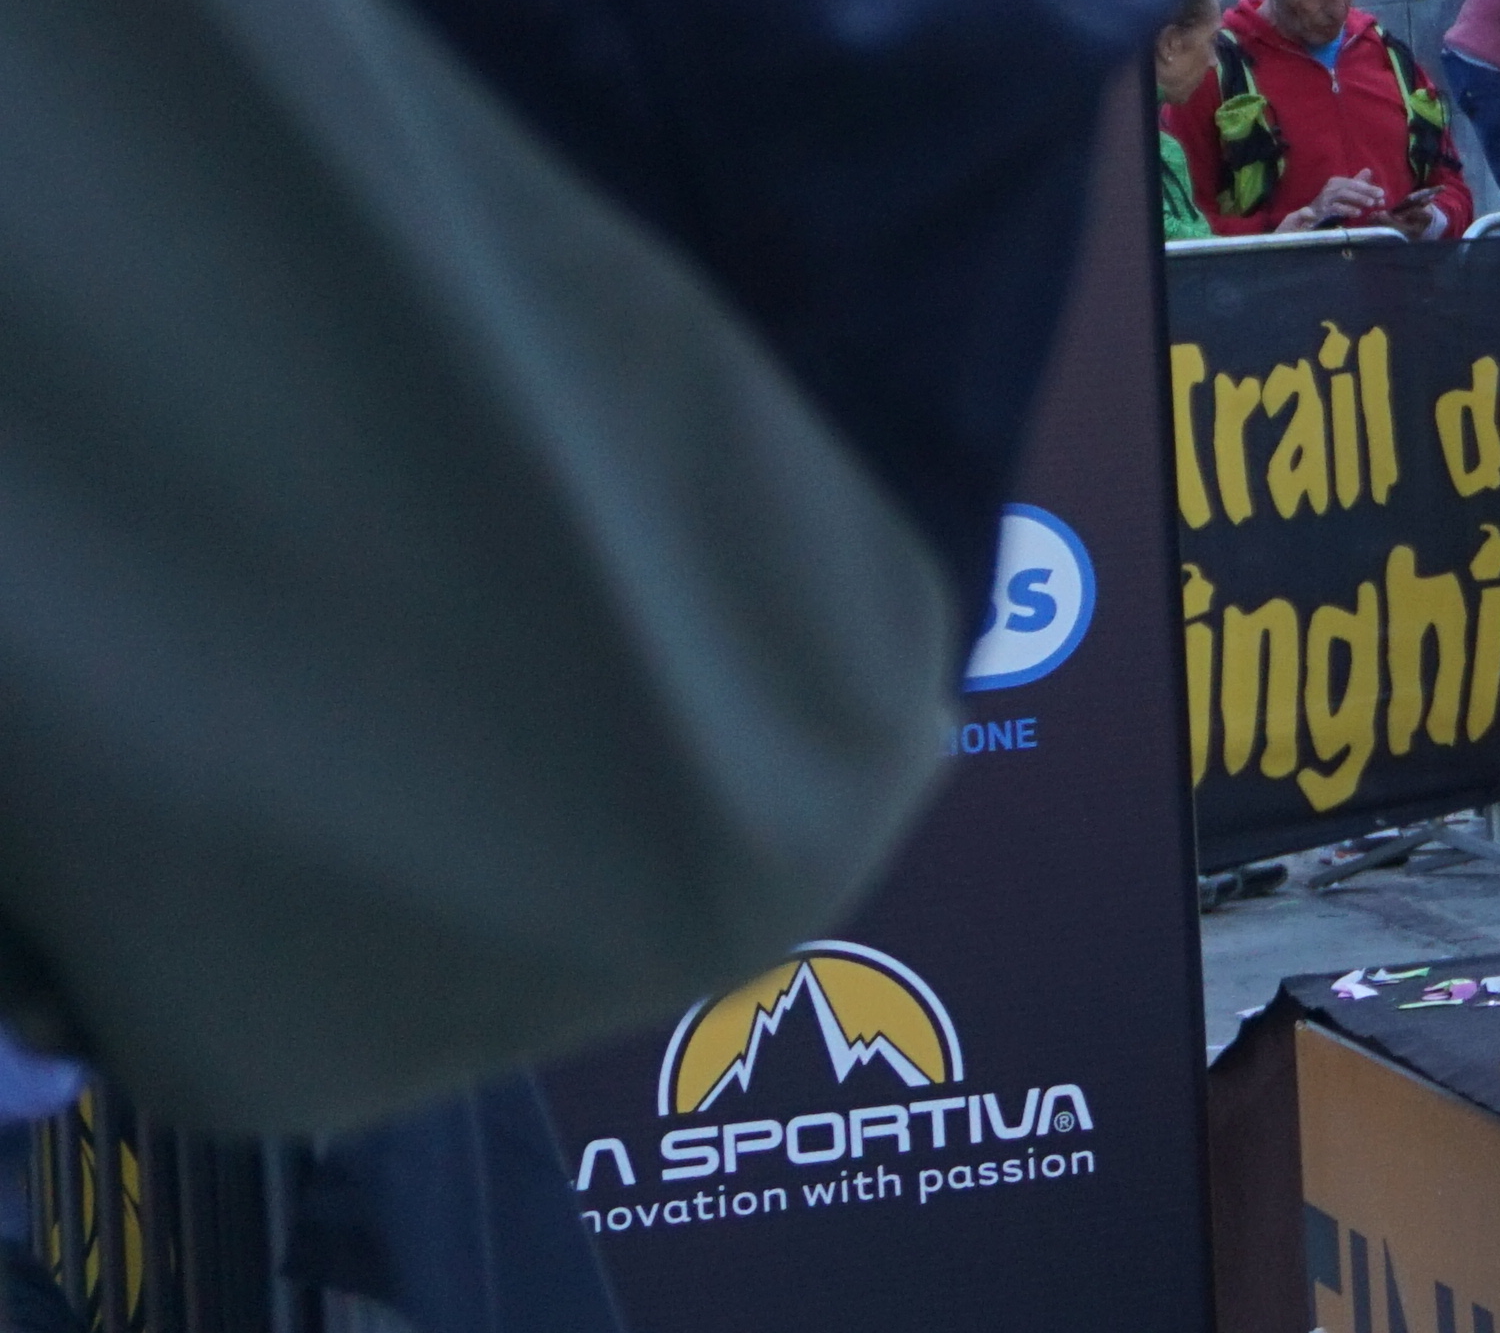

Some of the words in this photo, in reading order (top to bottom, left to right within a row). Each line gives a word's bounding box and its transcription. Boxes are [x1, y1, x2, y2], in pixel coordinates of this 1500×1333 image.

[570, 1137, 637, 1192] A
[802, 1165, 902, 1208] with
[919, 1148, 1097, 1205] passion
